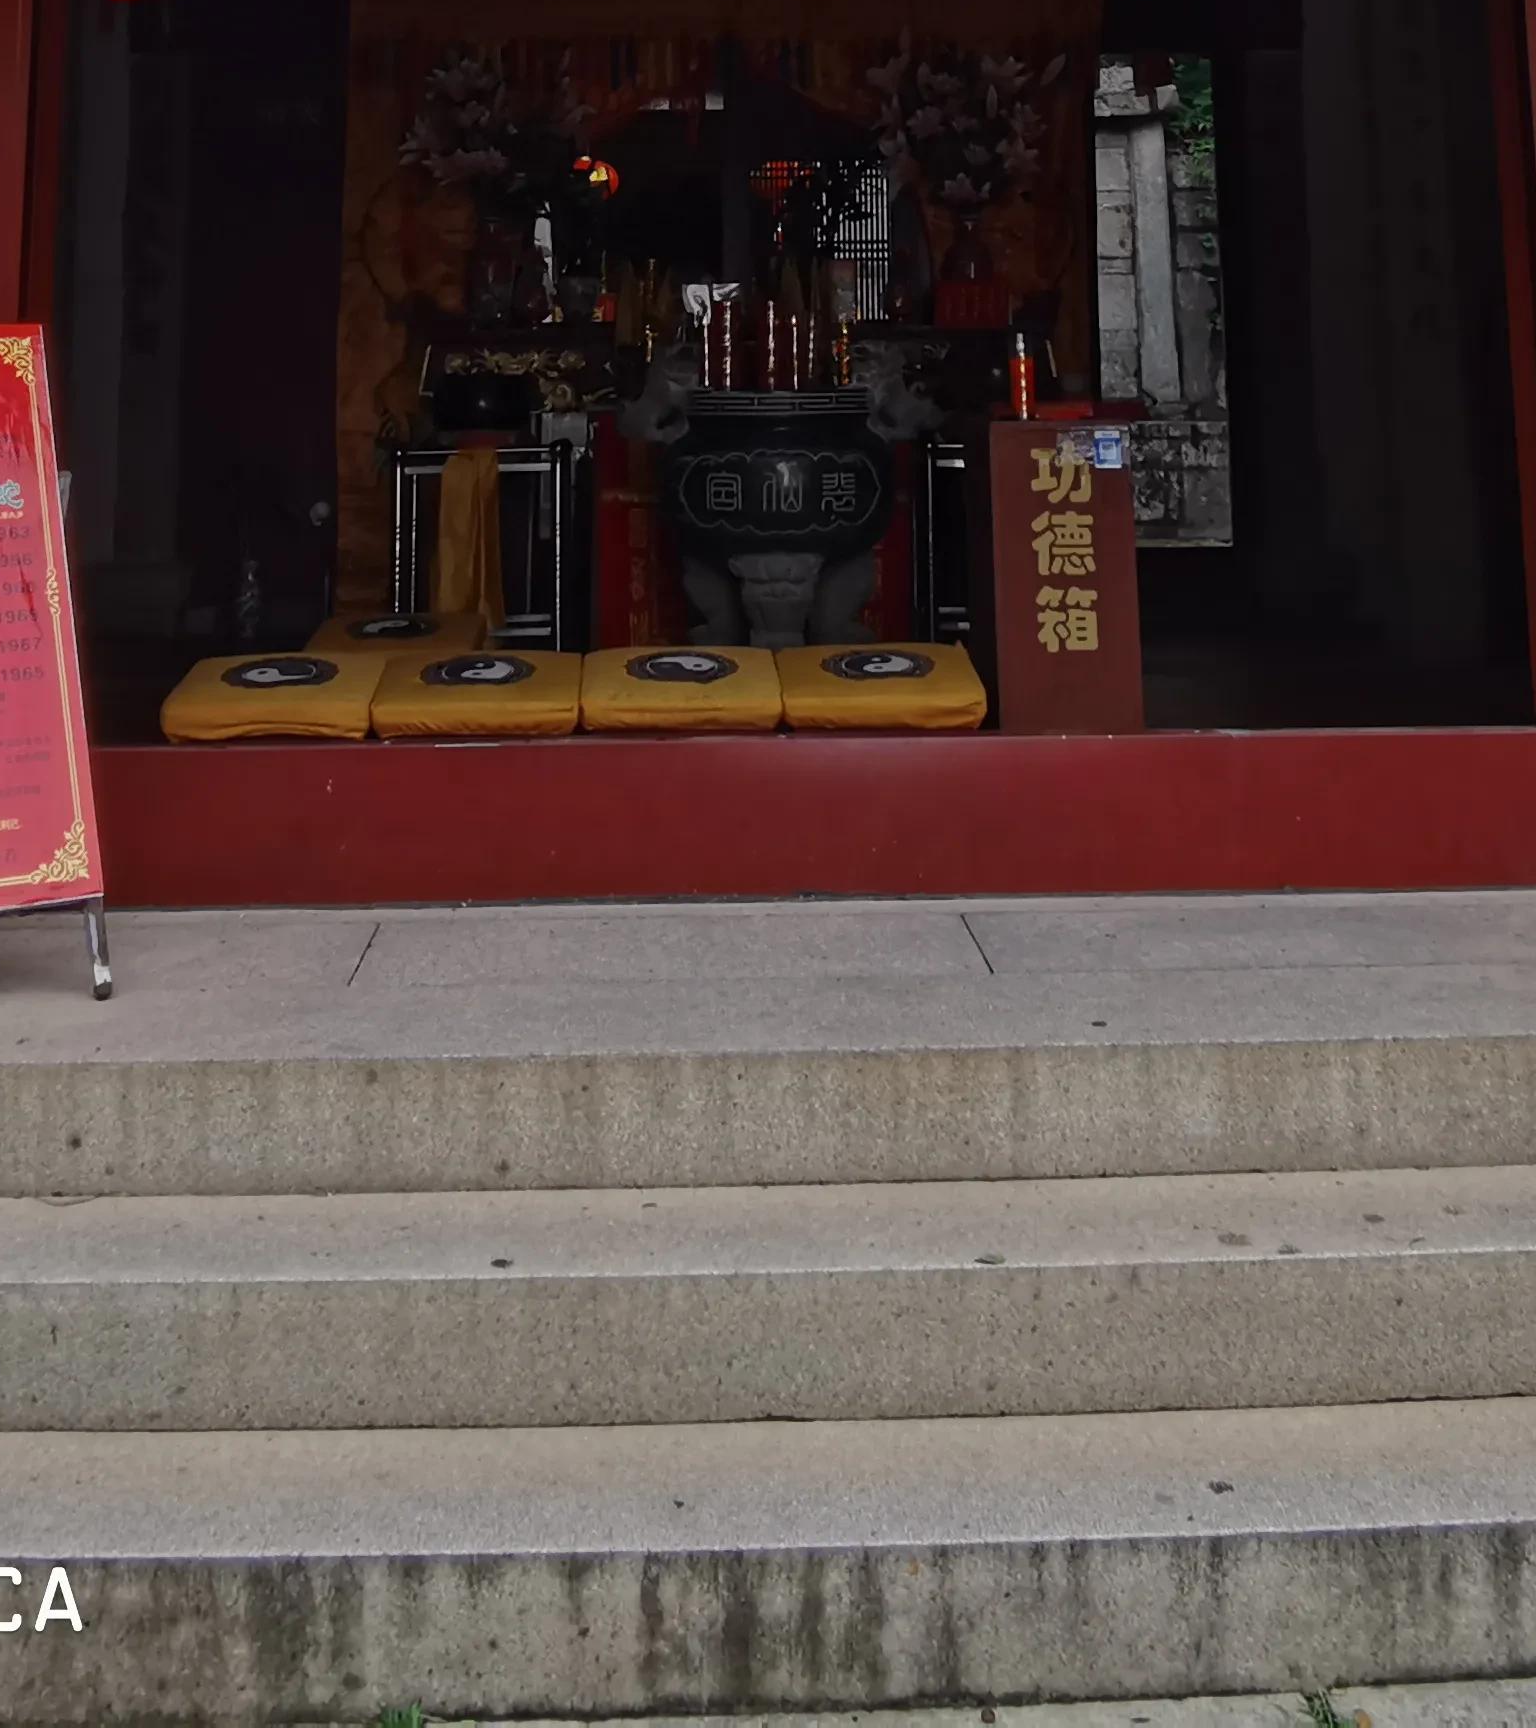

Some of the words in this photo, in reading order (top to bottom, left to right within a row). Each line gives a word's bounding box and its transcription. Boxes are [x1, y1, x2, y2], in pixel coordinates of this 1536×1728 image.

[1030, 440, 1099, 654] 功德箱
[0, 666, 45, 683] 1965
